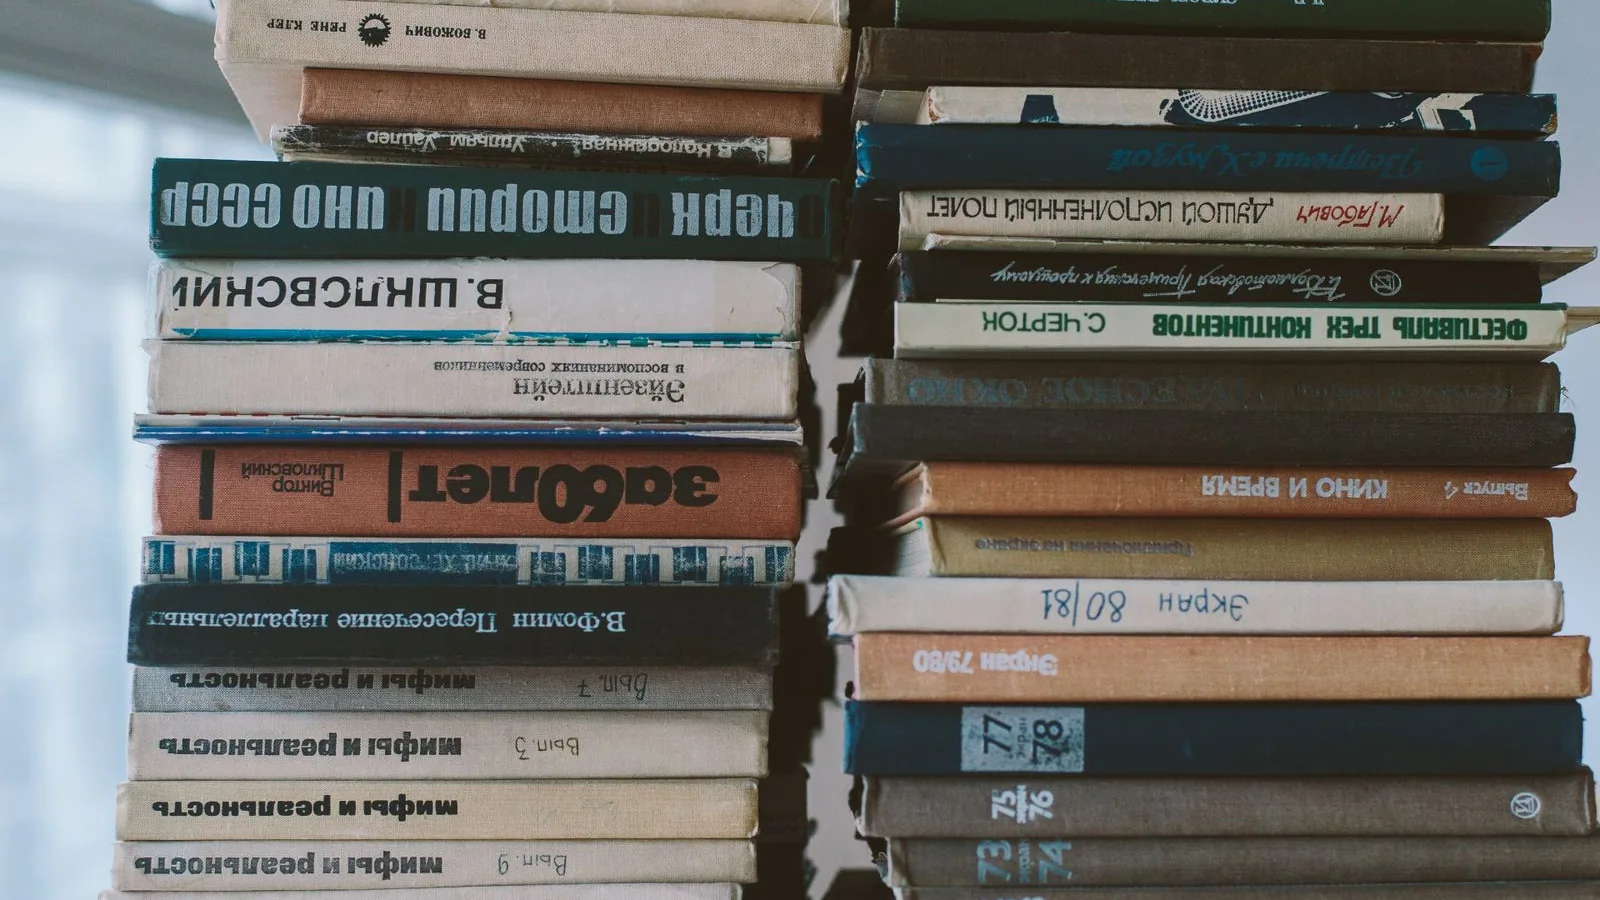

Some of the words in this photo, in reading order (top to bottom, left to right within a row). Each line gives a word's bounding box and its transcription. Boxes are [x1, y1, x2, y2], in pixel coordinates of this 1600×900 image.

[266, 18, 303, 31] КЛЕР
[310, 20, 347, 33] РЕНЕ
[404, 25, 471, 40] БОЖОВИЧ
[474, 28, 487, 41] В.
[366, 131, 437, 153] Уайлер
[926, 195, 998, 219] ПОЛЕТ
[1004, 197, 1172, 225] ИСПОЛНЕННЫЙ
[1181, 197, 1275, 226] ДУШОЙ
[467, 278, 503, 310] В.
[1152, 314, 1312, 339] КОНТИНЕНТОВ
[1326, 316, 1382, 340] ТРЕХ
[1392, 316, 1528, 341] ФЕСТИВАЛЬ
[433, 359, 546, 374] современников
[551, 362, 670, 375] воспоминаниях
[675, 363, 685, 375] в
[513, 378, 686, 404] Эйзенштейн
[241, 462, 345, 482] Шкловский
[272, 475, 335, 498] Виктор
[1202, 475, 1280, 499] ВРЕМЯ
[1289, 477, 1308, 499] И
[1315, 477, 1388, 500] КИНО
[1444, 481, 1459, 500] 4
[1463, 480, 1529, 501] Выпуск
[1041, 580, 1127, 627] 80/81
[1159, 587, 1249, 622] Экран
[337, 608, 499, 633] Пересечение
[912, 649, 975, 675] 79/80
[980, 649, 1059, 676] Экран
[169, 668, 349, 690] реальность
[356, 674, 374, 689] и
[381, 669, 476, 695] мифы
[577, 679, 592, 698] 7
[598, 673, 648, 701] Вып.
[159, 732, 338, 757] реальность
[983, 714, 1012, 754] 77
[343, 738, 361, 756] и
[368, 731, 462, 763] мифы
[514, 736, 531, 761] 3
[532, 737, 580, 757] Вып.
[152, 795, 331, 817] реальность
[338, 800, 356, 817] и
[363, 794, 459, 822] мифы
[991, 789, 1017, 820] 75
[1028, 790, 1054, 821] 76
[134, 852, 316, 875] реальность
[322, 857, 340, 875] и
[347, 850, 443, 881] мифы
[976, 840, 1012, 884] 73
[1038, 841, 1073, 883] 74
